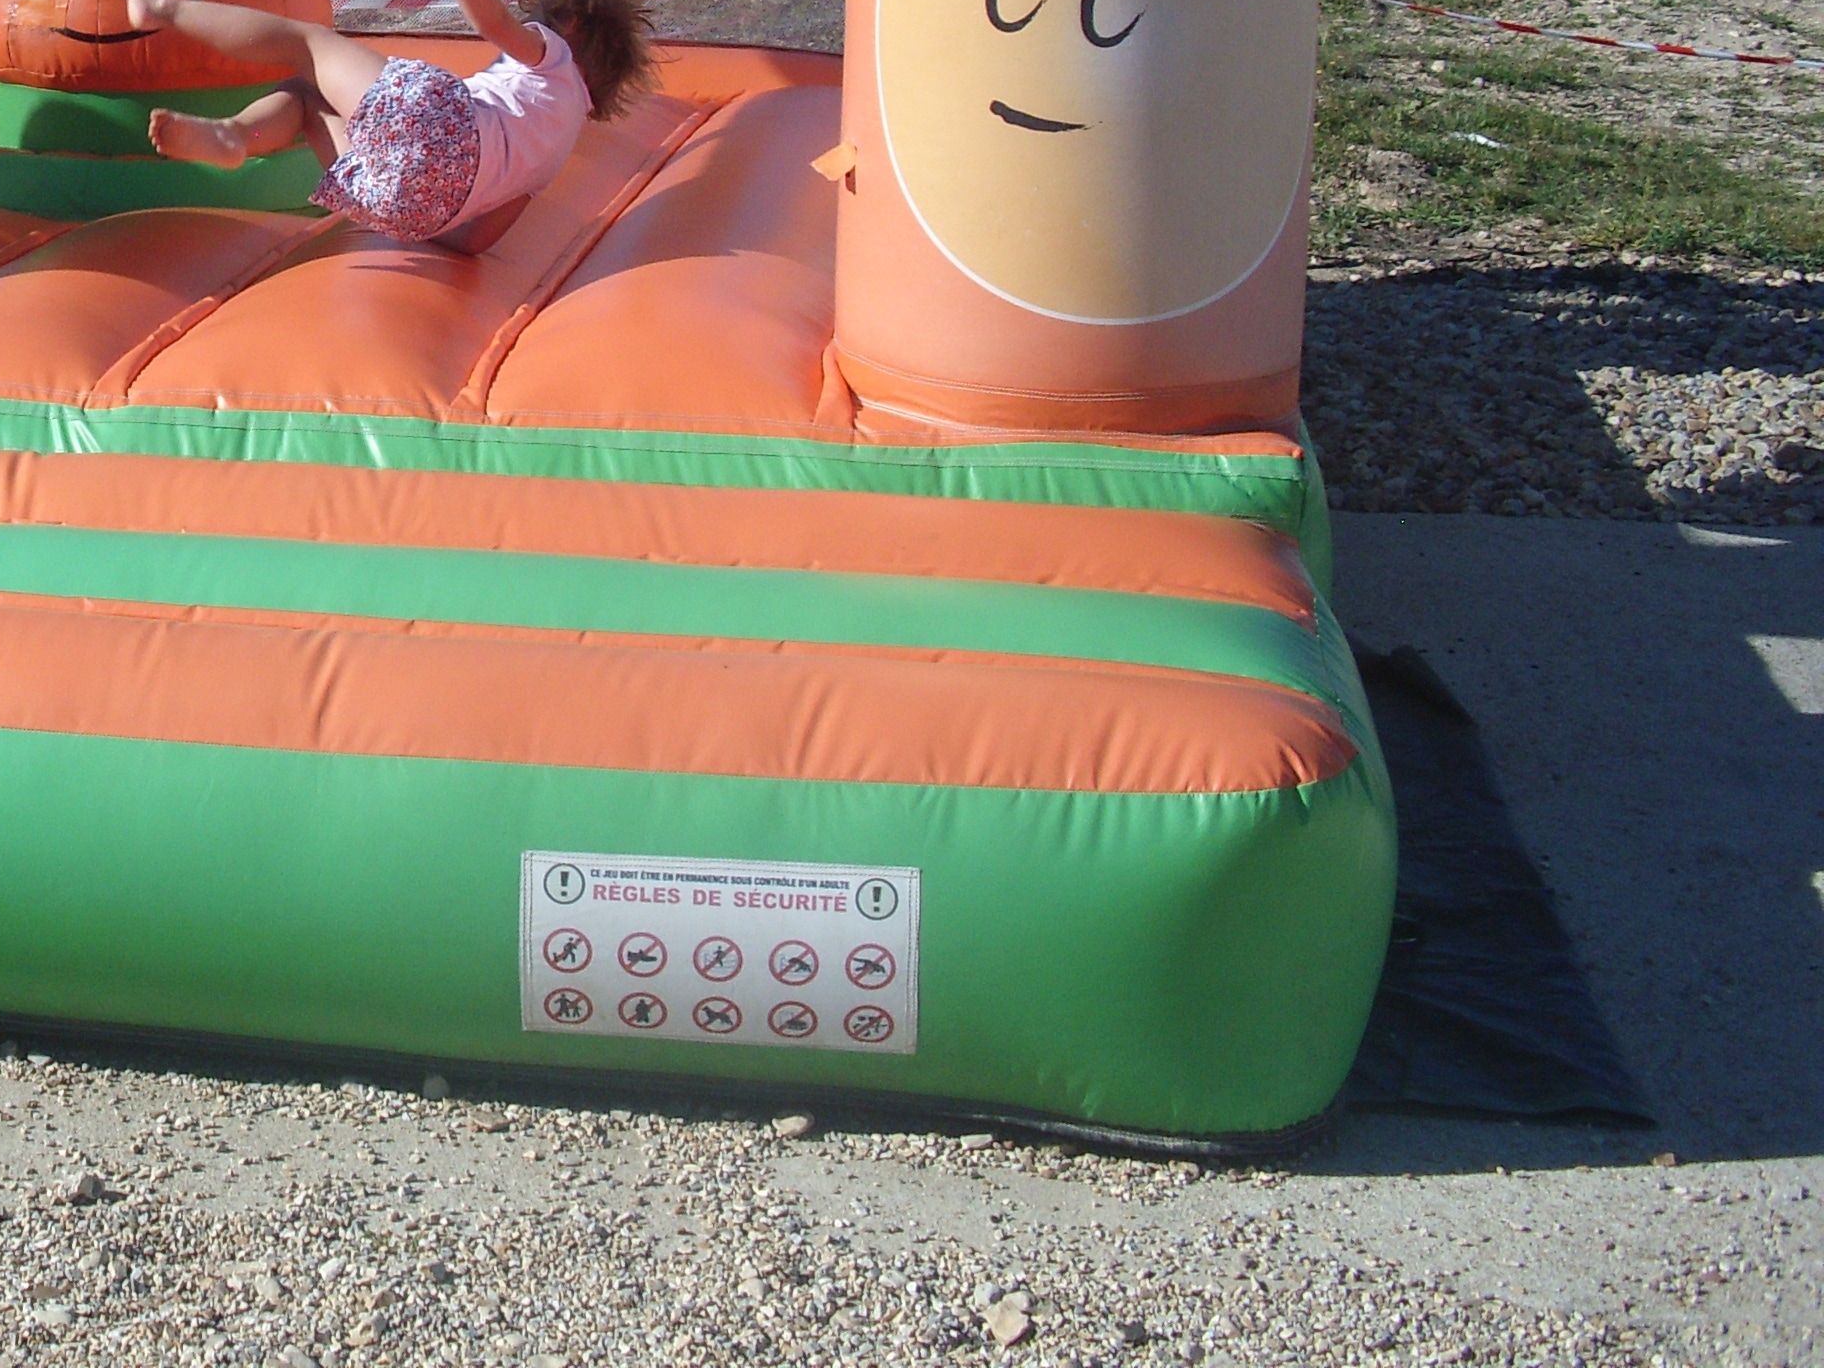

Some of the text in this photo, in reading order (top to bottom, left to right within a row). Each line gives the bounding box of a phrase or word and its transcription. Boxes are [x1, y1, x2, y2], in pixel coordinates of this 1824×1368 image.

[590, 868, 601, 878] CE
[602, 869, 618, 879] JEU
[620, 870, 638, 880] DOIT
[662, 872, 674, 881] EN
[675, 872, 728, 885] PERMANENCE
[731, 875, 752, 885] SOUS
[754, 875, 796, 888] CONTRÔLE
[819, 880, 850, 890] ADULTE
[592, 880, 847, 913] RÈGLES DE SÉCURITÉ
